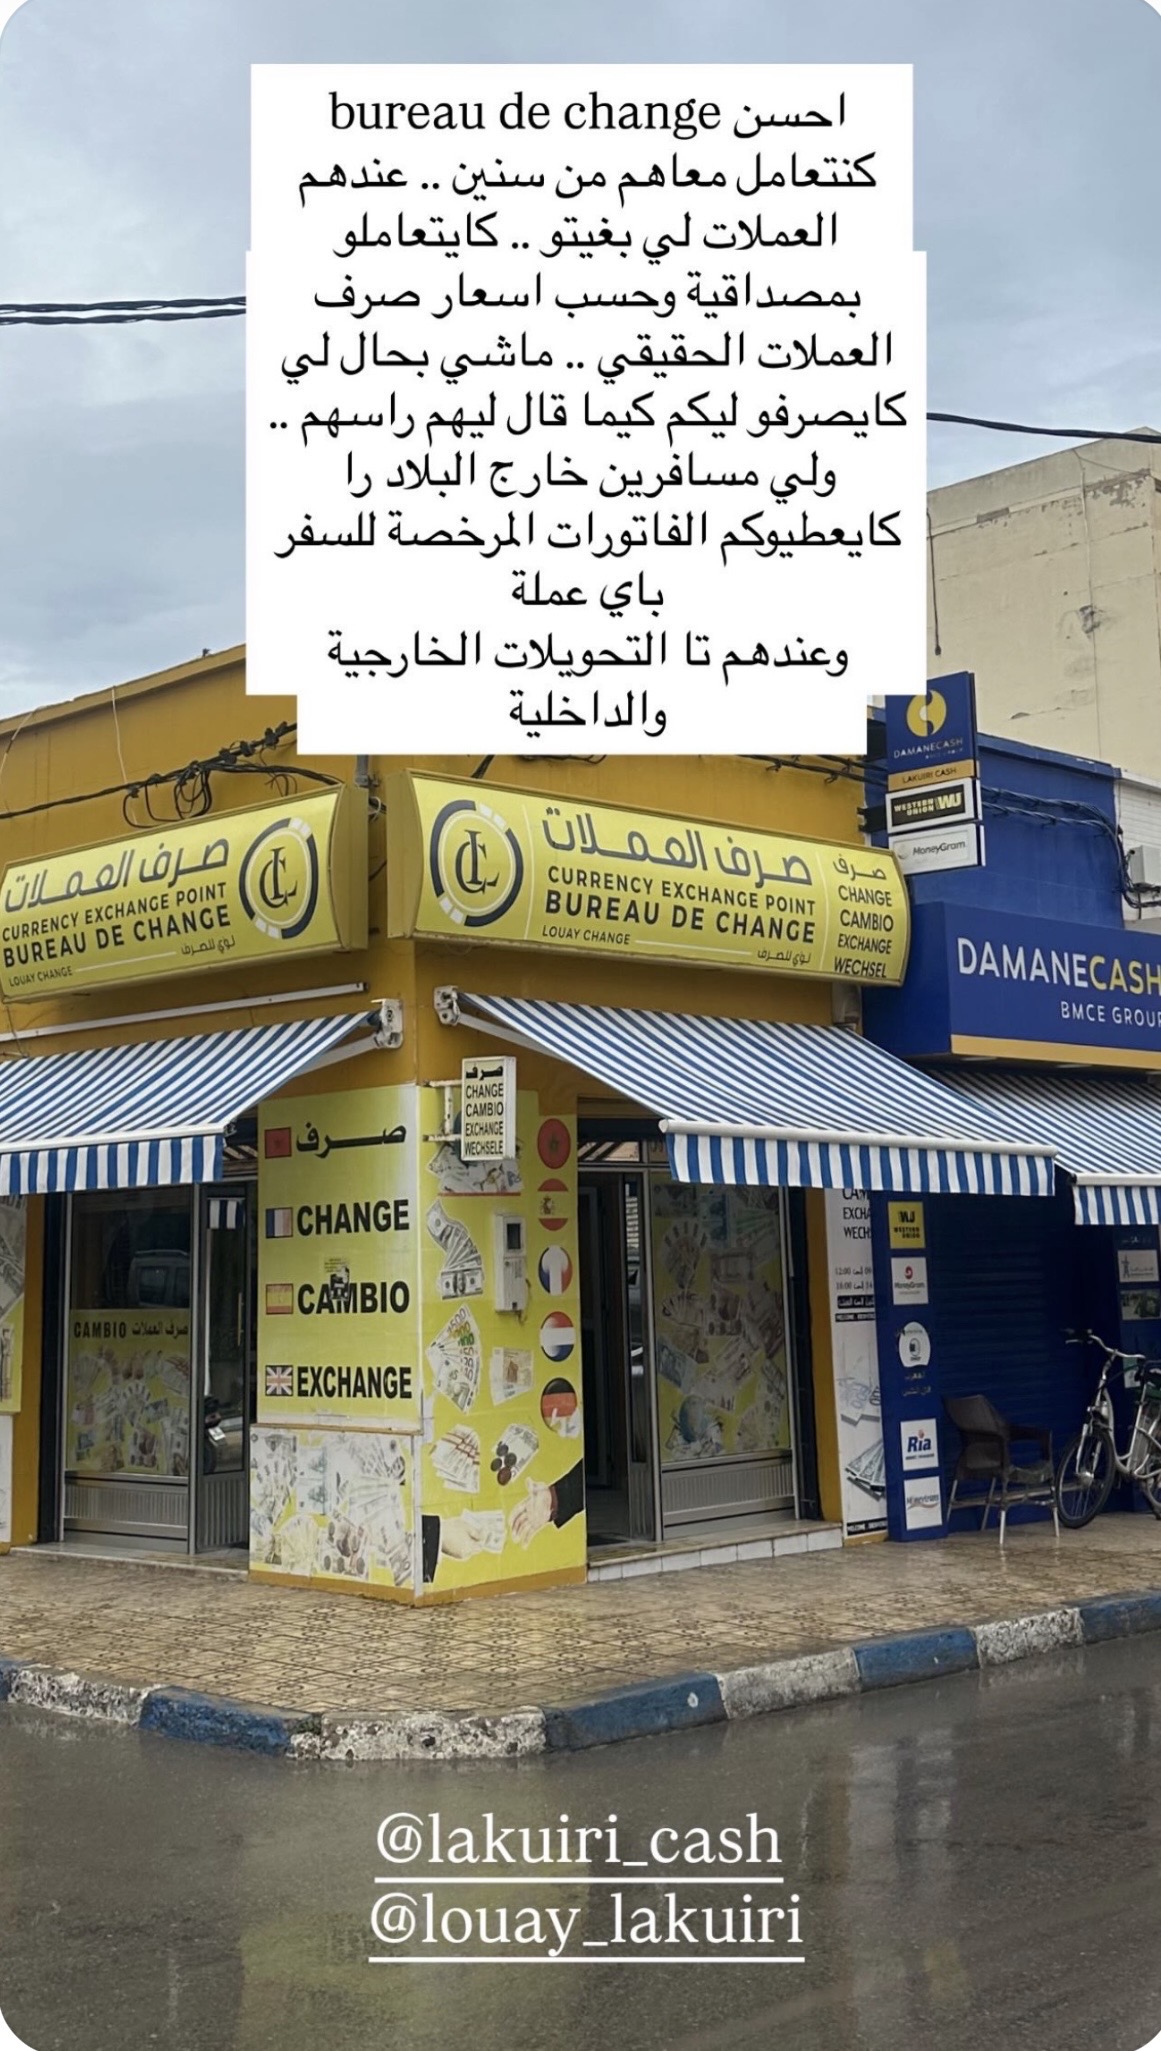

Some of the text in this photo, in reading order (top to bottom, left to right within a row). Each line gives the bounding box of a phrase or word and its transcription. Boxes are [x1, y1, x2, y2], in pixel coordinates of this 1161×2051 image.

[893, 738, 964, 759] DAMANECASH
[935, 767, 957, 778] CASH
[894, 798, 934, 812] WESTERN
[907, 805, 934, 816] UNION
[542, 806, 813, 889] صرف العملات
[913, 841, 966, 856] MoneyGram
[4, 838, 230, 914] صرف العملات
[833, 853, 887, 881] صرف
[547, 865, 816, 916] CURRENCY EXCHANGE POINT
[838, 884, 892, 907] CHANGE
[2, 882, 227, 942] CURRENCY EXCHANGE POINT
[545, 890, 816, 944] BUREAU DE CHANGE
[840, 909, 894, 932] CAMBIO
[4, 904, 231, 968] BUREAU DE CHANGE
[542, 925, 631, 946] LOUAY CHANGE
[837, 933, 892, 954] EXCHANGE
[9, 965, 73, 988] LOUAY CHANGE
[834, 956, 887, 978] WECHSEL
[957, 937, 1161, 996] DAMANECASH
[1061, 1001, 1106, 1022] BMCE
[465, 1083, 504, 1099] CHANGE
[465, 1102, 504, 1117] CAMBIO
[465, 1121, 504, 1136] EXCHANGE
[296, 1122, 407, 1158] صرف
[464, 1140, 504, 1155] WECHSELE
[297, 1199, 410, 1236] CHANGE
[297, 1281, 411, 1315] CAMBIO
[74, 1322, 127, 1338] CAMBIO
[297, 1366, 412, 1399] EXCHANGE
[907, 1436, 931, 1452] Ria
